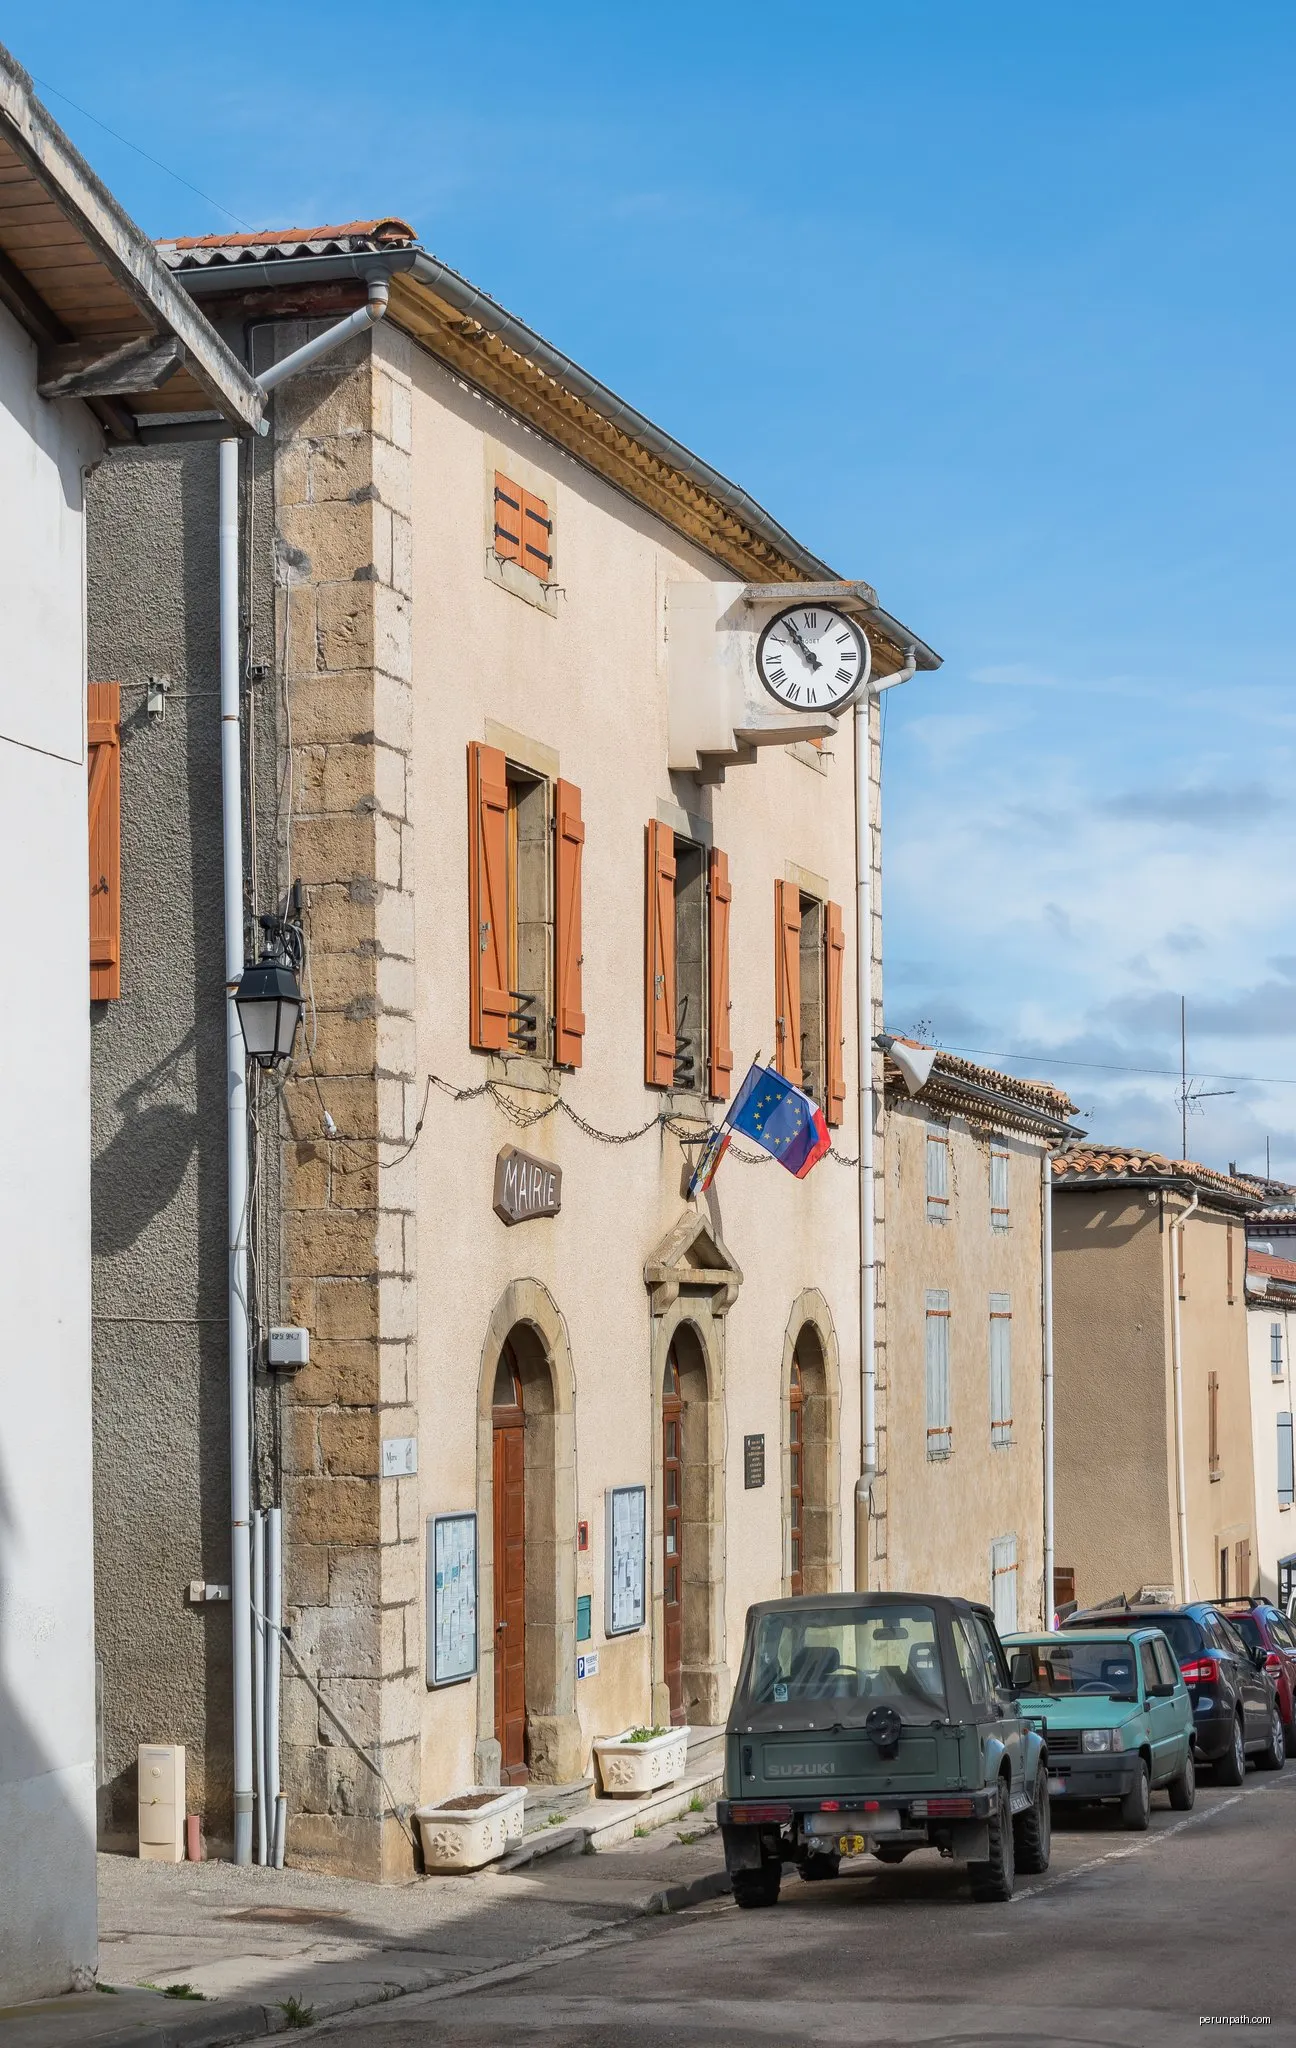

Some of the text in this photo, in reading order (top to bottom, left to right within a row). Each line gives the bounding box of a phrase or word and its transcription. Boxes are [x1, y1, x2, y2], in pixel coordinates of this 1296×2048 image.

[804, 612, 817, 629] XII
[824, 617, 834, 633] I
[770, 634, 786, 646] X
[835, 632, 851, 645] II
[765, 654, 782, 665] IX
[840, 652, 857, 661] III
[769, 668, 788, 689] VIII
[834, 667, 853, 684] IIII
[785, 682, 801, 702] VII
[807, 687, 817, 703] VI
[826, 682, 838, 698] V
[503, 1160, 556, 1211] MAIRIE
[579, 1659, 584, 1676] P
[768, 1763, 835, 1776] SUZUKI
